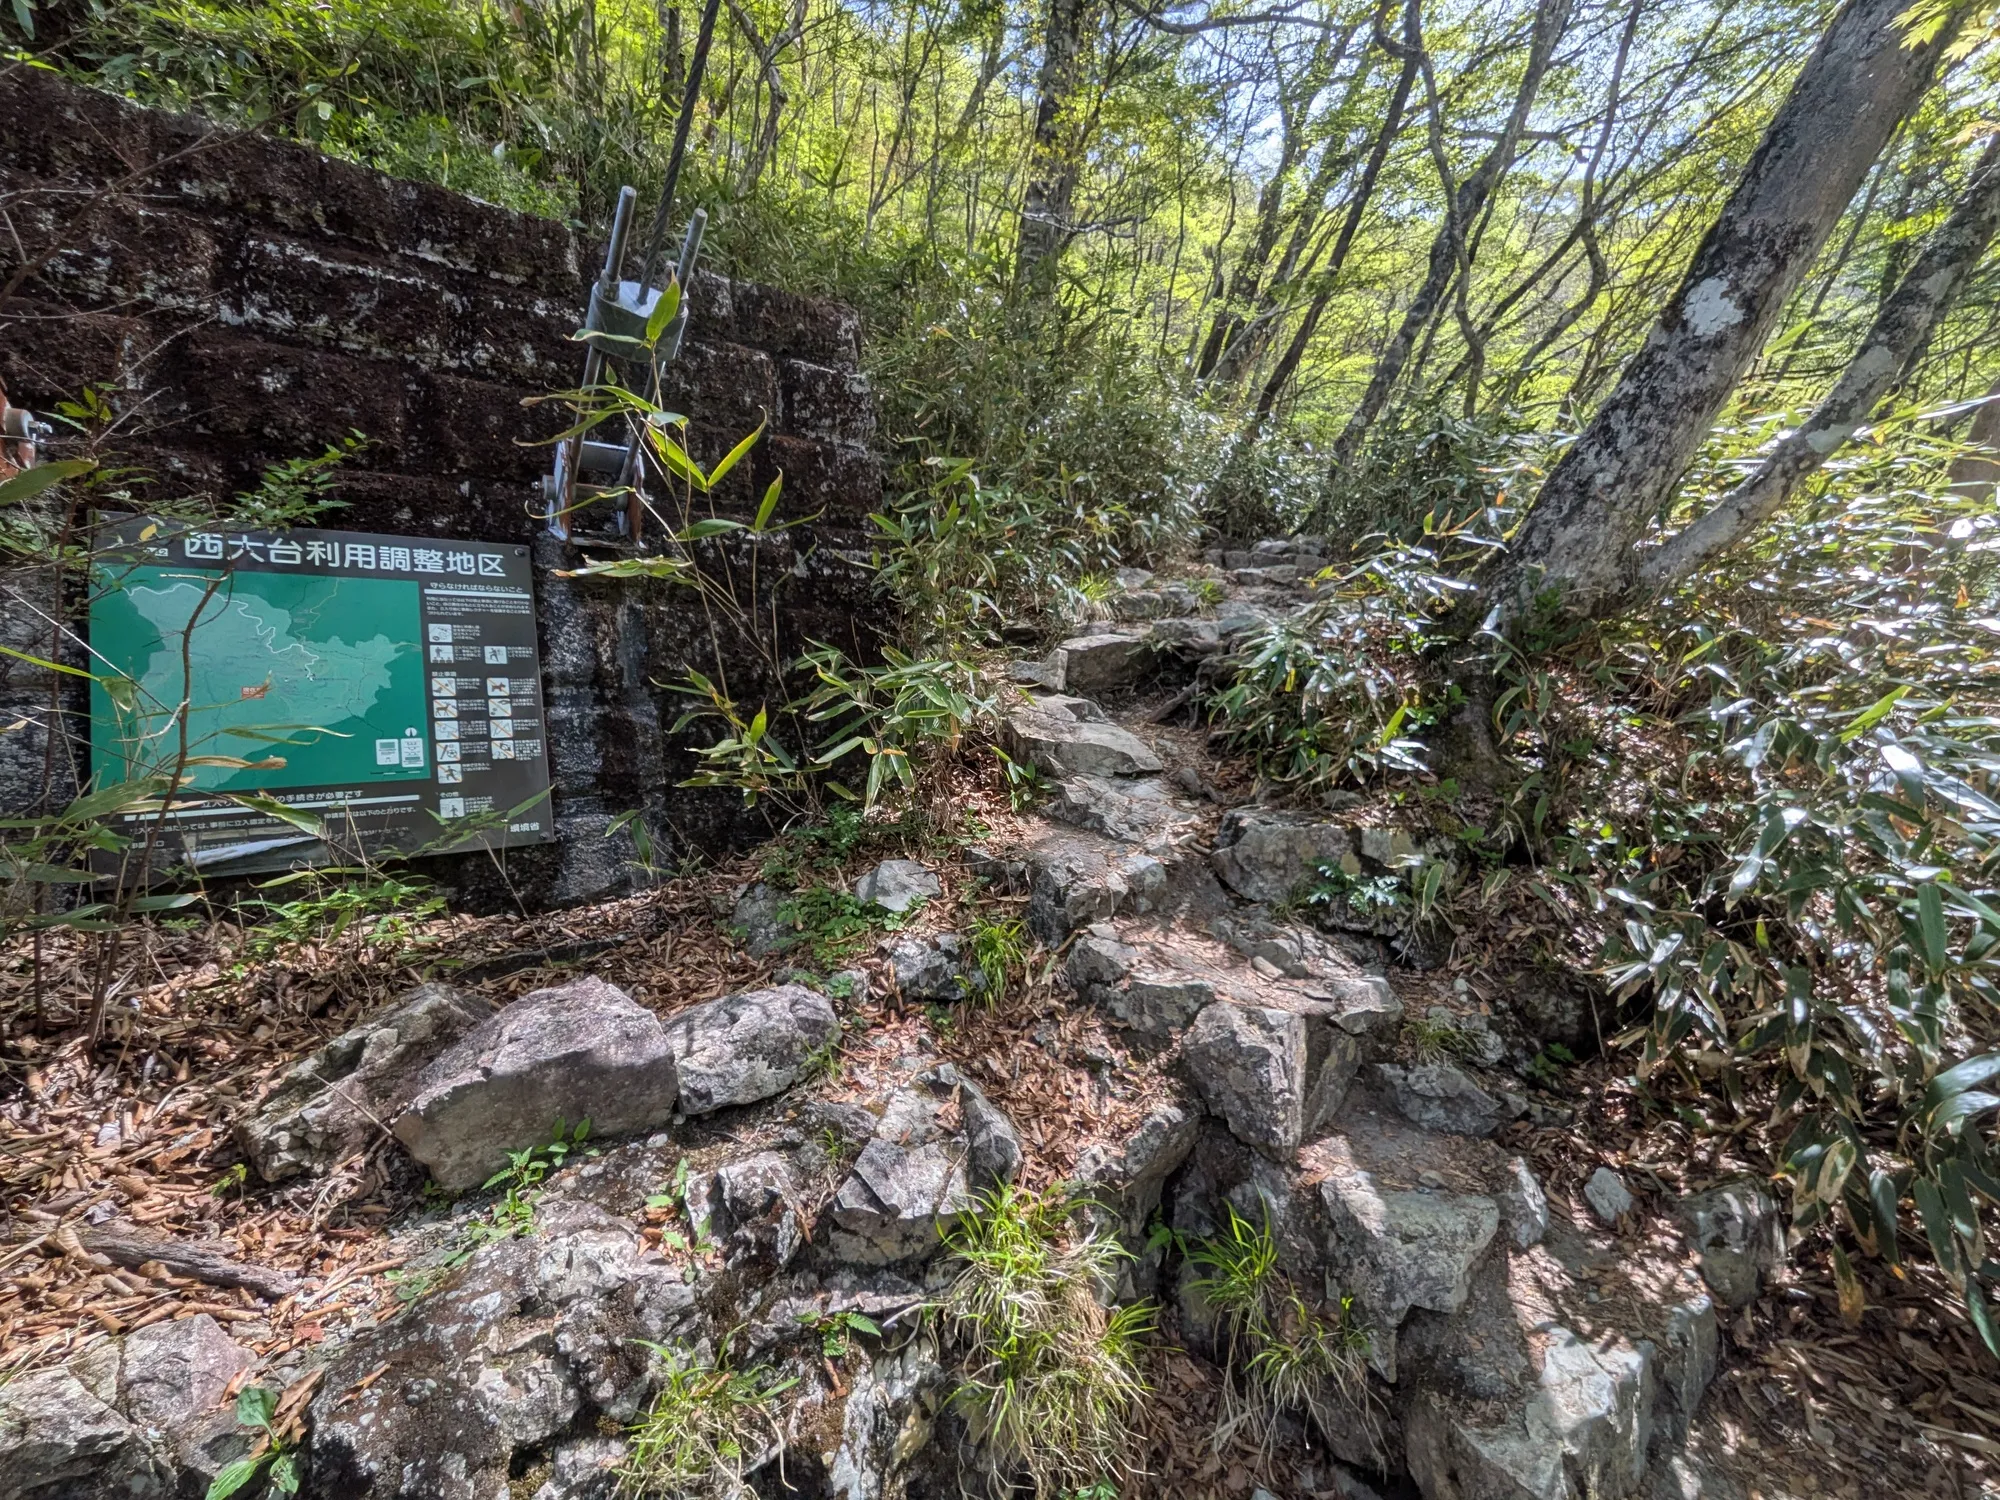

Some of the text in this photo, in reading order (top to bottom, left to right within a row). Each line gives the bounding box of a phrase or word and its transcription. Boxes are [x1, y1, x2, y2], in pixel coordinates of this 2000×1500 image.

[185, 531, 506, 577] 西大台利用調整地区
[430, 582, 523, 594] 守らなければならないこと
